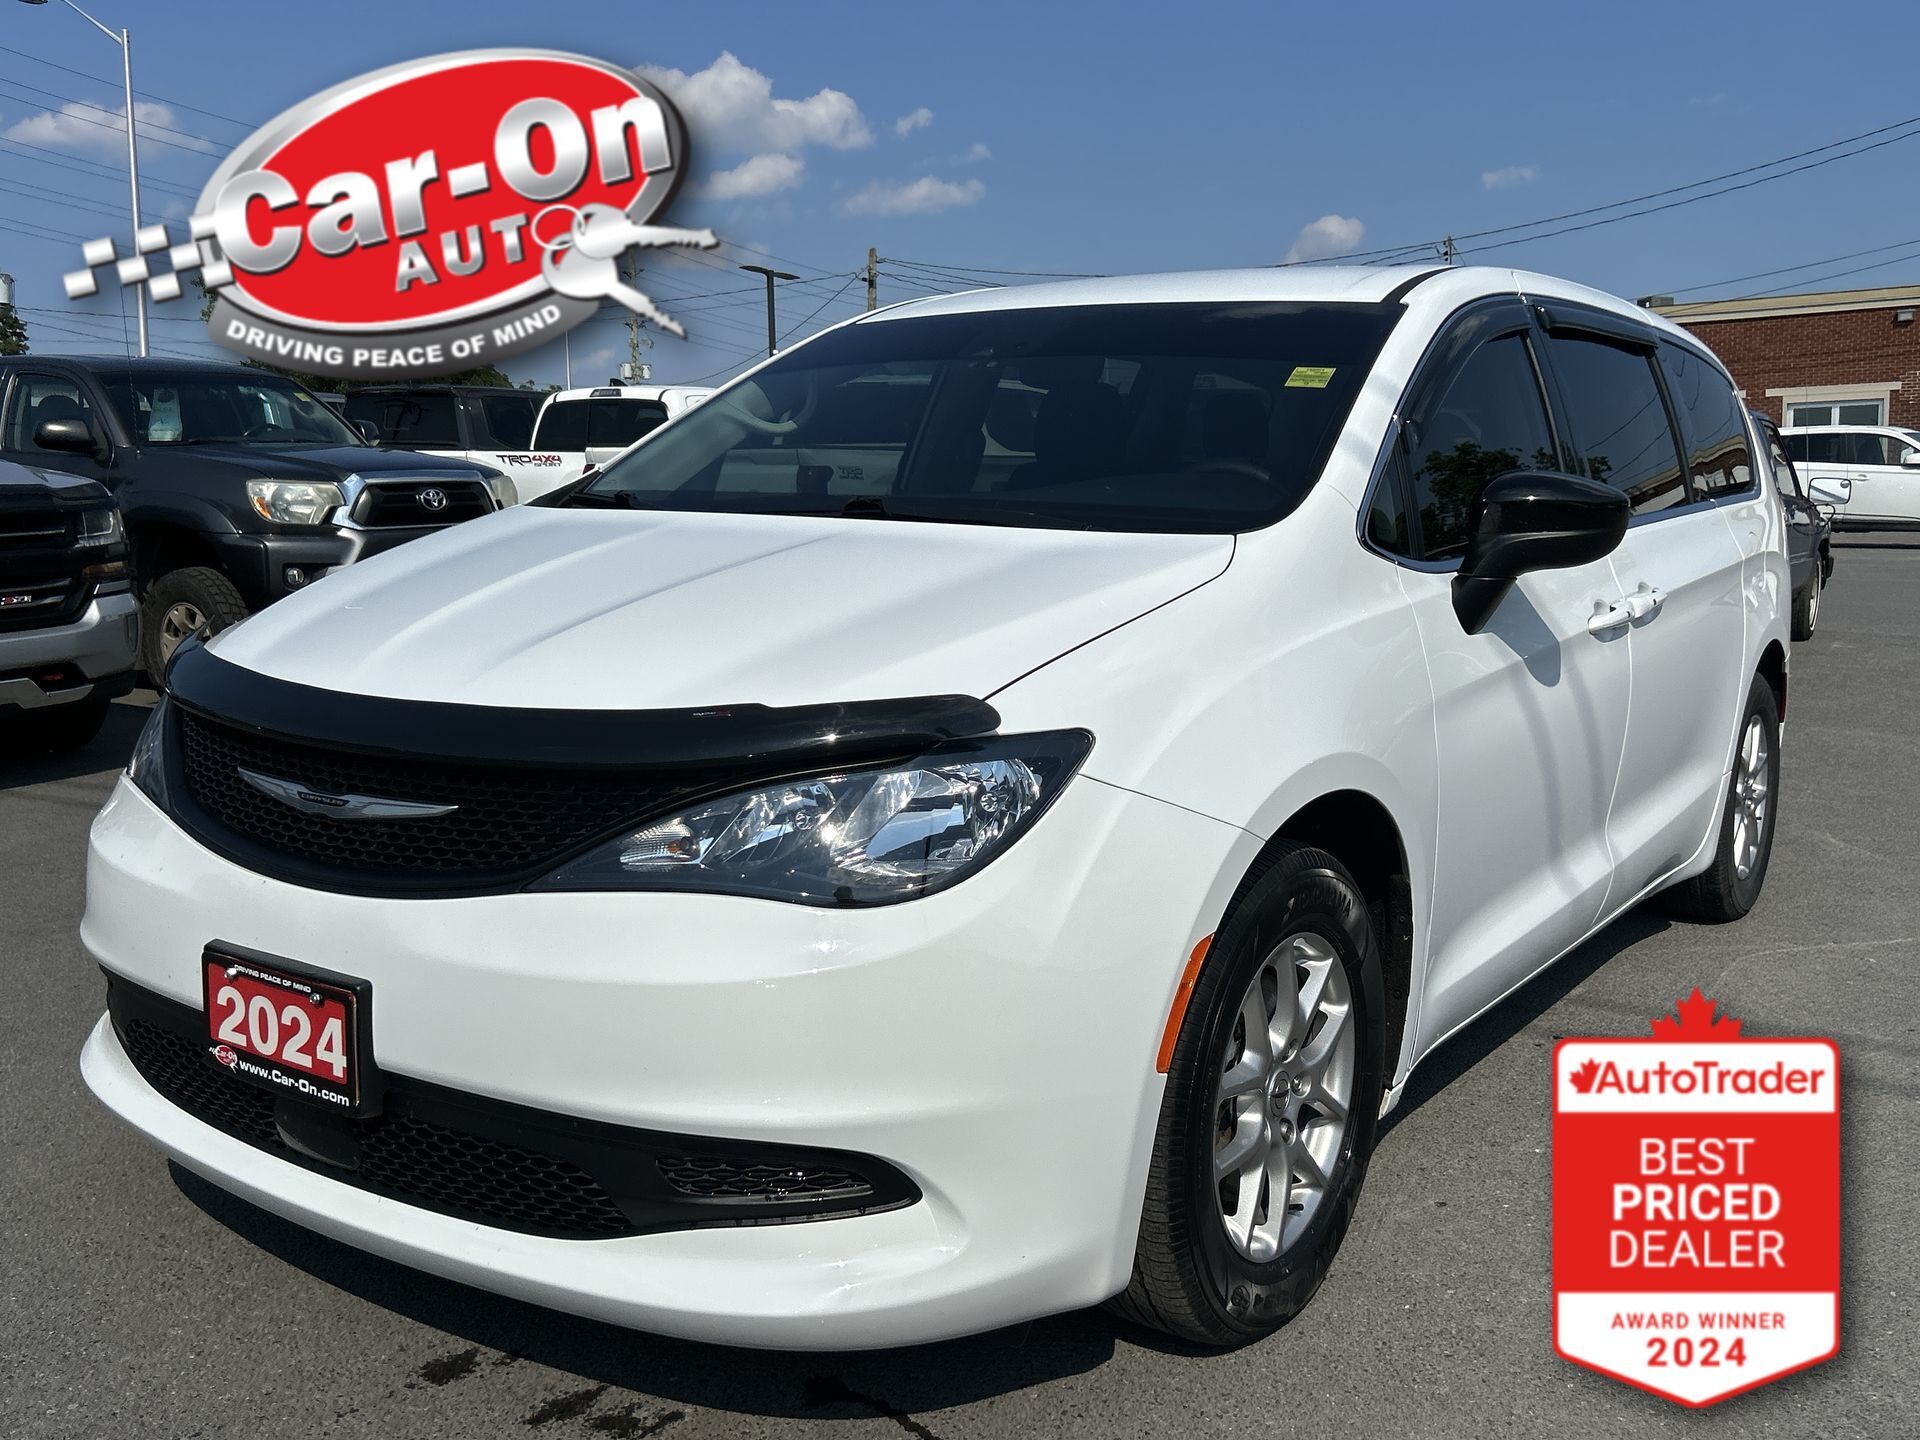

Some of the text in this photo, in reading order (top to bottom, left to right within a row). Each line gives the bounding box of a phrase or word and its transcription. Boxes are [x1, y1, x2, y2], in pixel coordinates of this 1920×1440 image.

[260, 972, 282, 985] PEACE
[282, 979, 293, 987] OF
[292, 982, 312, 994] MIND
[216, 985, 347, 1078] 2024
[239, 1059, 351, 1107] www.Car-On.com
